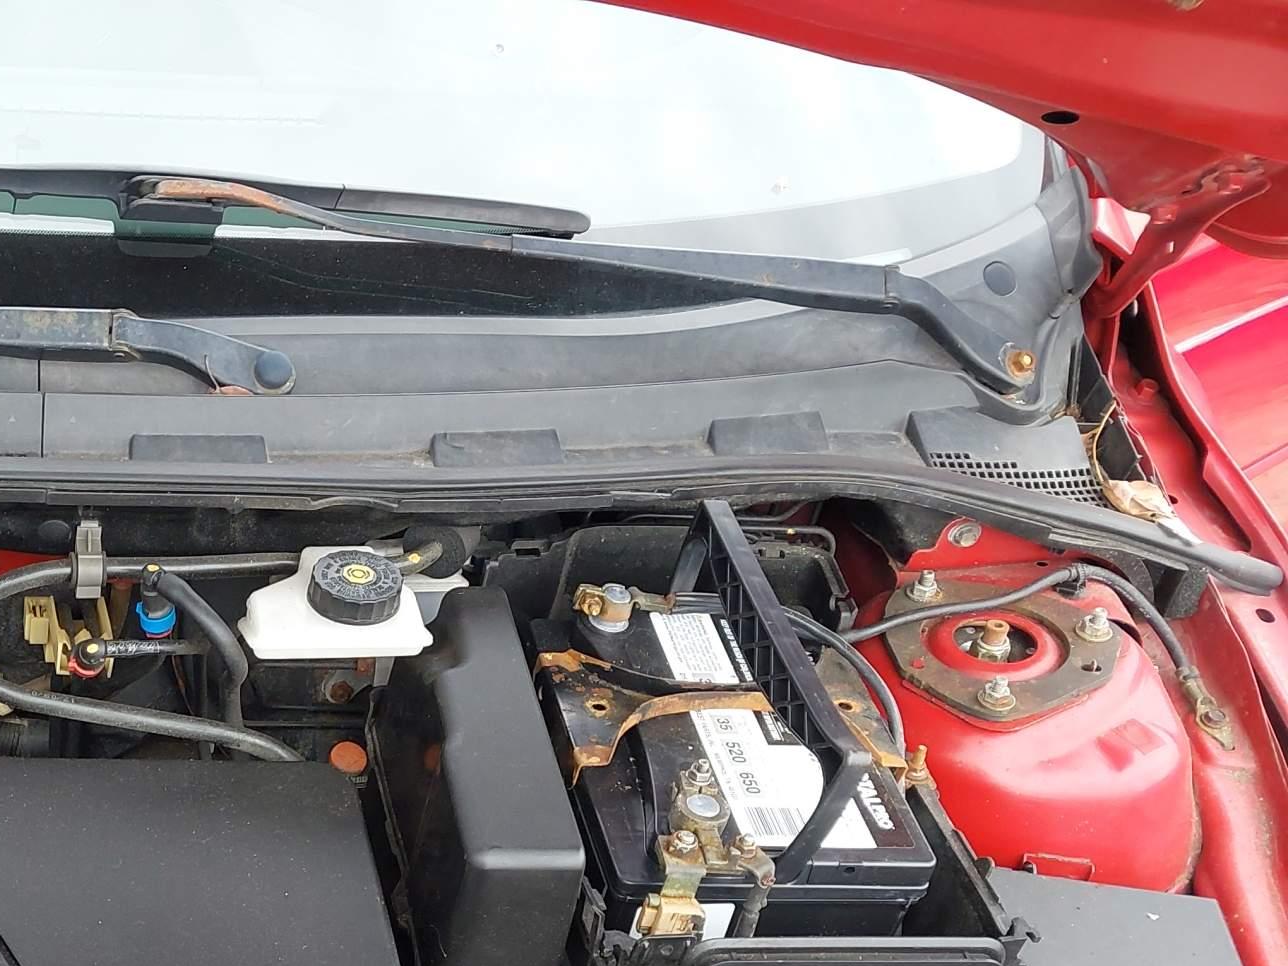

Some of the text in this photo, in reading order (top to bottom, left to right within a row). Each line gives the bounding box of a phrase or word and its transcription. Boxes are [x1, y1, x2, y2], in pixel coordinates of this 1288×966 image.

[717, 718, 733, 732] 35
[726, 741, 747, 764] 520
[739, 772, 761, 795] 650
